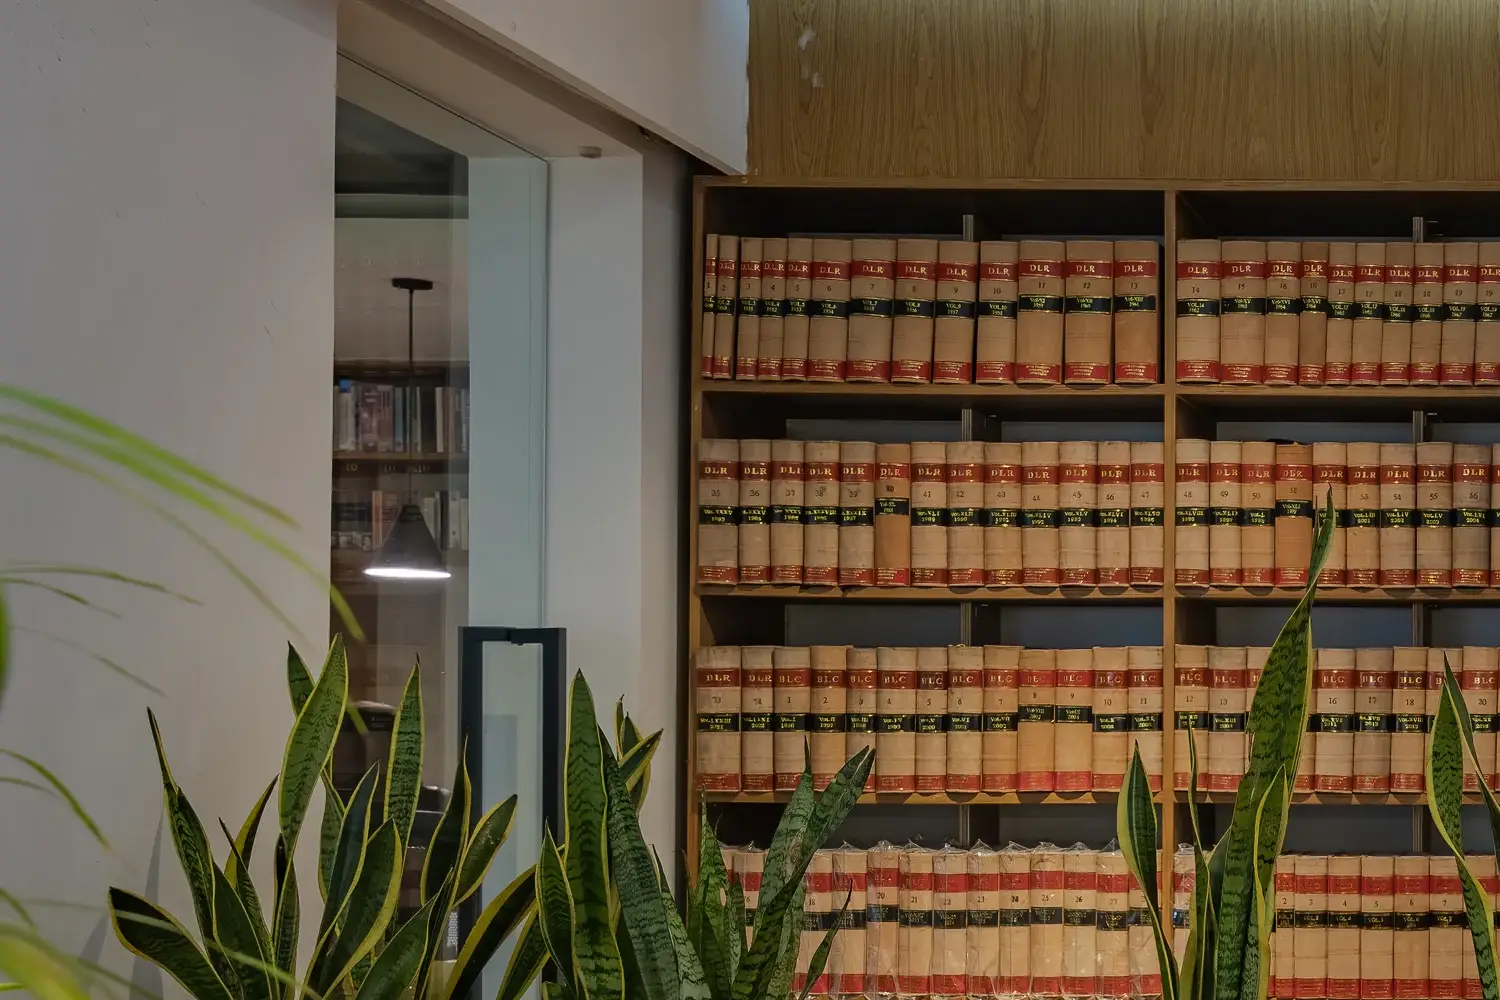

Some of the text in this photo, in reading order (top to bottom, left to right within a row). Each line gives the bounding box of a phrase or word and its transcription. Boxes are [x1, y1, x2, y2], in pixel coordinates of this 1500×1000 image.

[704, 466, 728, 474] DLR
[744, 467, 767, 475] DLR
[918, 468, 941, 476] DLR
[991, 469, 1014, 477] DLR
[1387, 470, 1409, 478] DLR
[1462, 468, 1485, 476] DLR
[1354, 471, 1376, 479] DLR
[1104, 698, 1112, 706] 10
[1329, 697, 1337, 705] 16
[1406, 698, 1414, 706] 18
